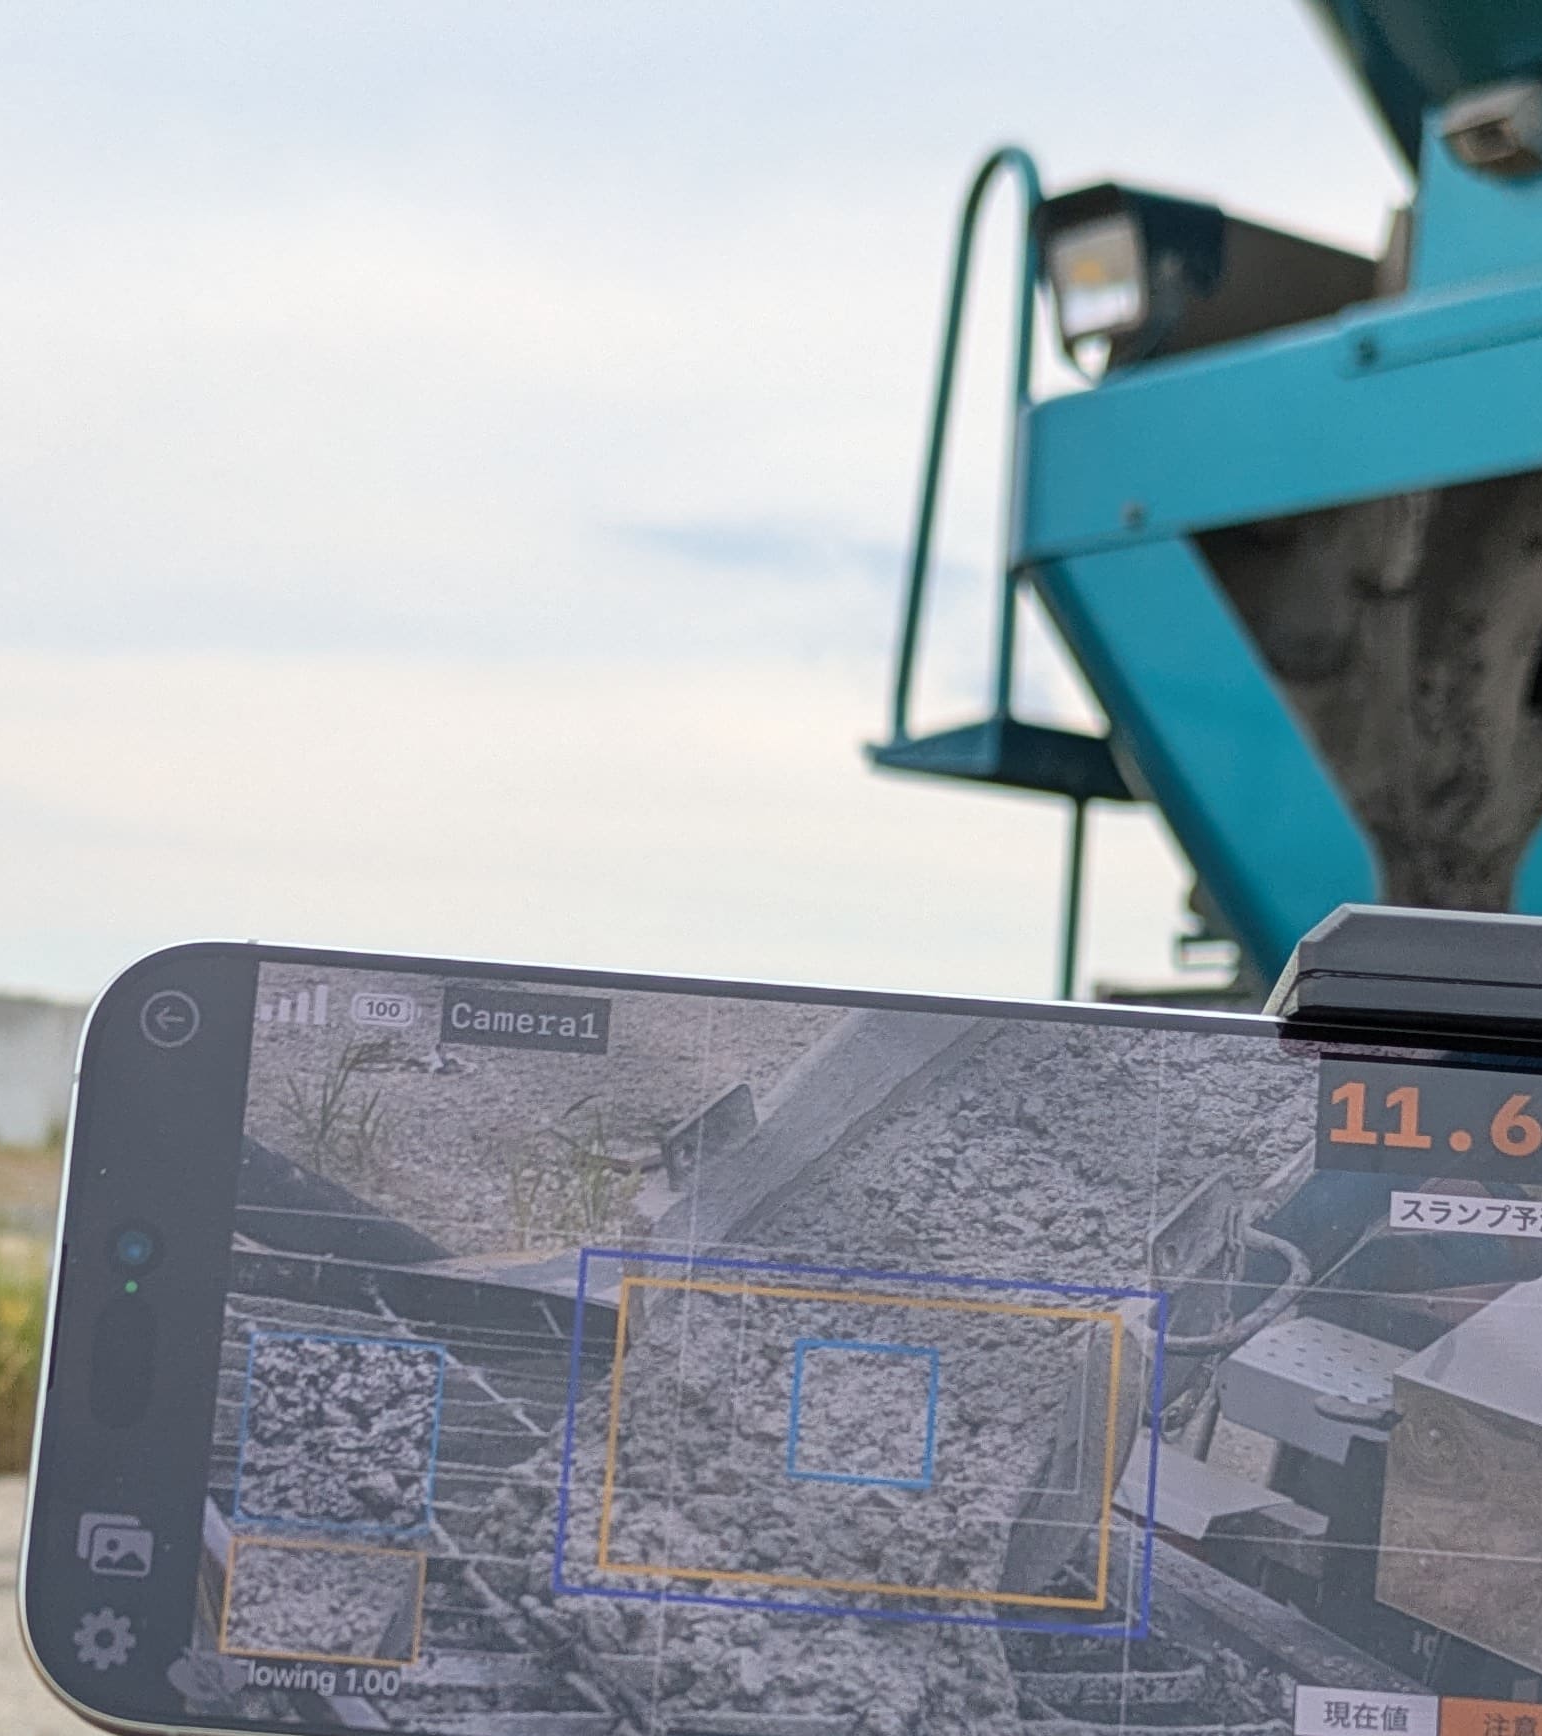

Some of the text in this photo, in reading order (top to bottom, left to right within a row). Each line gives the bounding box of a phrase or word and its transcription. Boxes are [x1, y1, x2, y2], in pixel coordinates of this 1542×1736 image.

[366, 1001, 401, 1018] 100
[451, 1003, 600, 1040] Camera1
[344, 1668, 400, 1696] 1.00
[1324, 1700, 1409, 1733] 現在値
